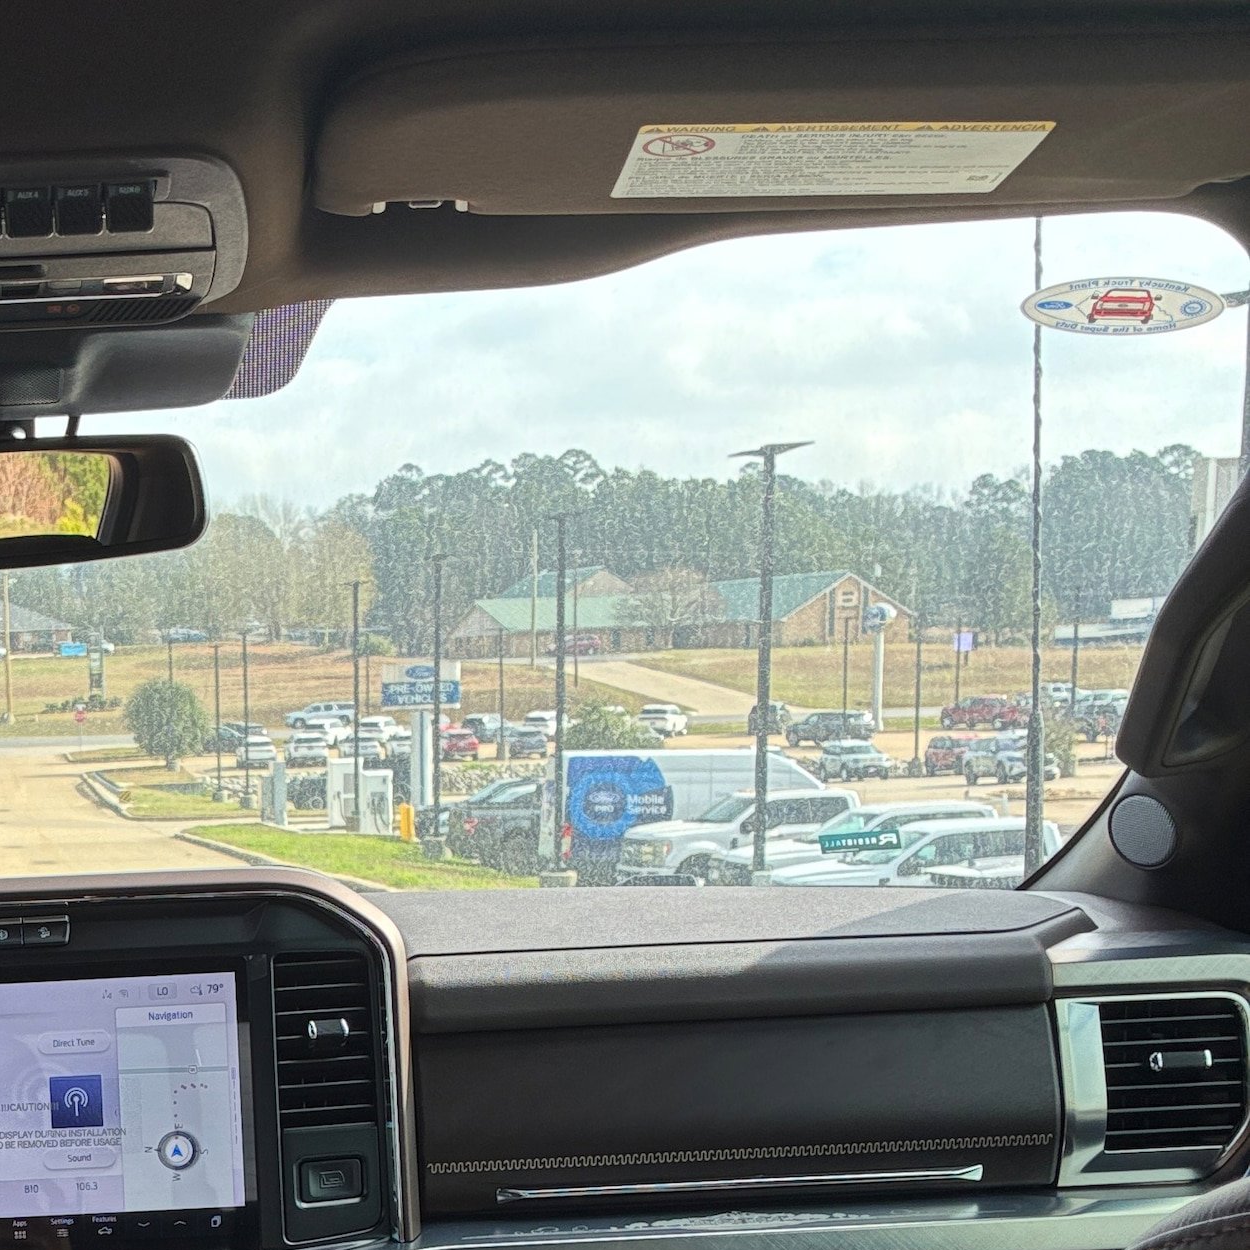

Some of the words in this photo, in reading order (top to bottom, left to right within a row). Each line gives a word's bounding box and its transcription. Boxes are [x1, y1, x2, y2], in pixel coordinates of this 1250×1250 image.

[775, 123, 900, 132] AVERTISSEMENT
[384, 682, 455, 695] PRE-OWED
[397, 693, 448, 704] VEHICLS
[627, 794, 665, 805] Mobile
[627, 806, 667, 816] Service
[157, 988, 168, 996] LO
[207, 983, 224, 994] 79°
[148, 1011, 193, 1021] Navigation
[53, 1039, 75, 1047] Direct
[76, 1038, 95, 1046] Tune
[0, 1131, 33, 1139] DISPLAY
[35, 1130, 67, 1138] DURING
[69, 1128, 126, 1137] INSTALLATION
[17, 1140, 58, 1148] REMOVED
[60, 1138, 92, 1147] BEFORE
[68, 1154, 92, 1162] Sound
[24, 1185, 39, 1193] 810
[76, 1182, 98, 1191] 106.3
